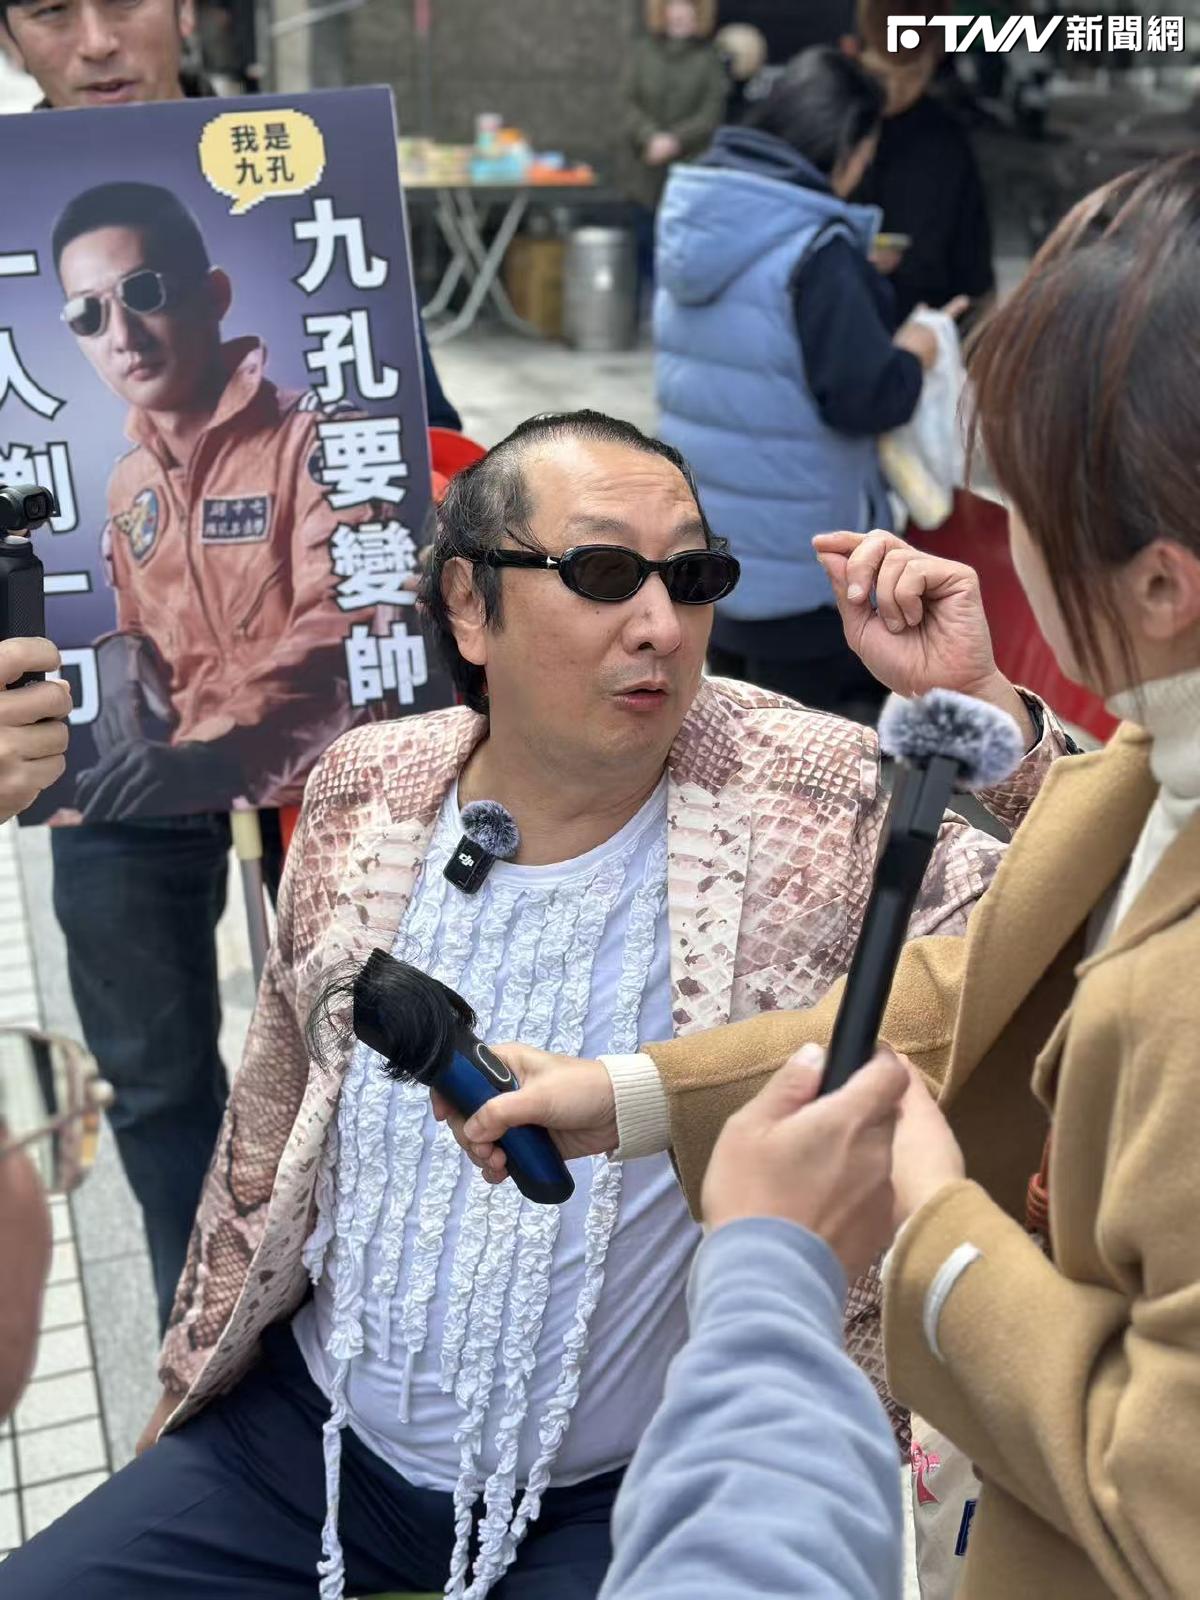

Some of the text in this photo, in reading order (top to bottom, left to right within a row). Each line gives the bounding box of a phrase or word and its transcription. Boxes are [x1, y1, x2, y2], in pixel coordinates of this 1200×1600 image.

[230, 123, 291, 153] 我是
[235, 155, 295, 184] 九孔
[294, 198, 428, 707] 九孔要變帥
